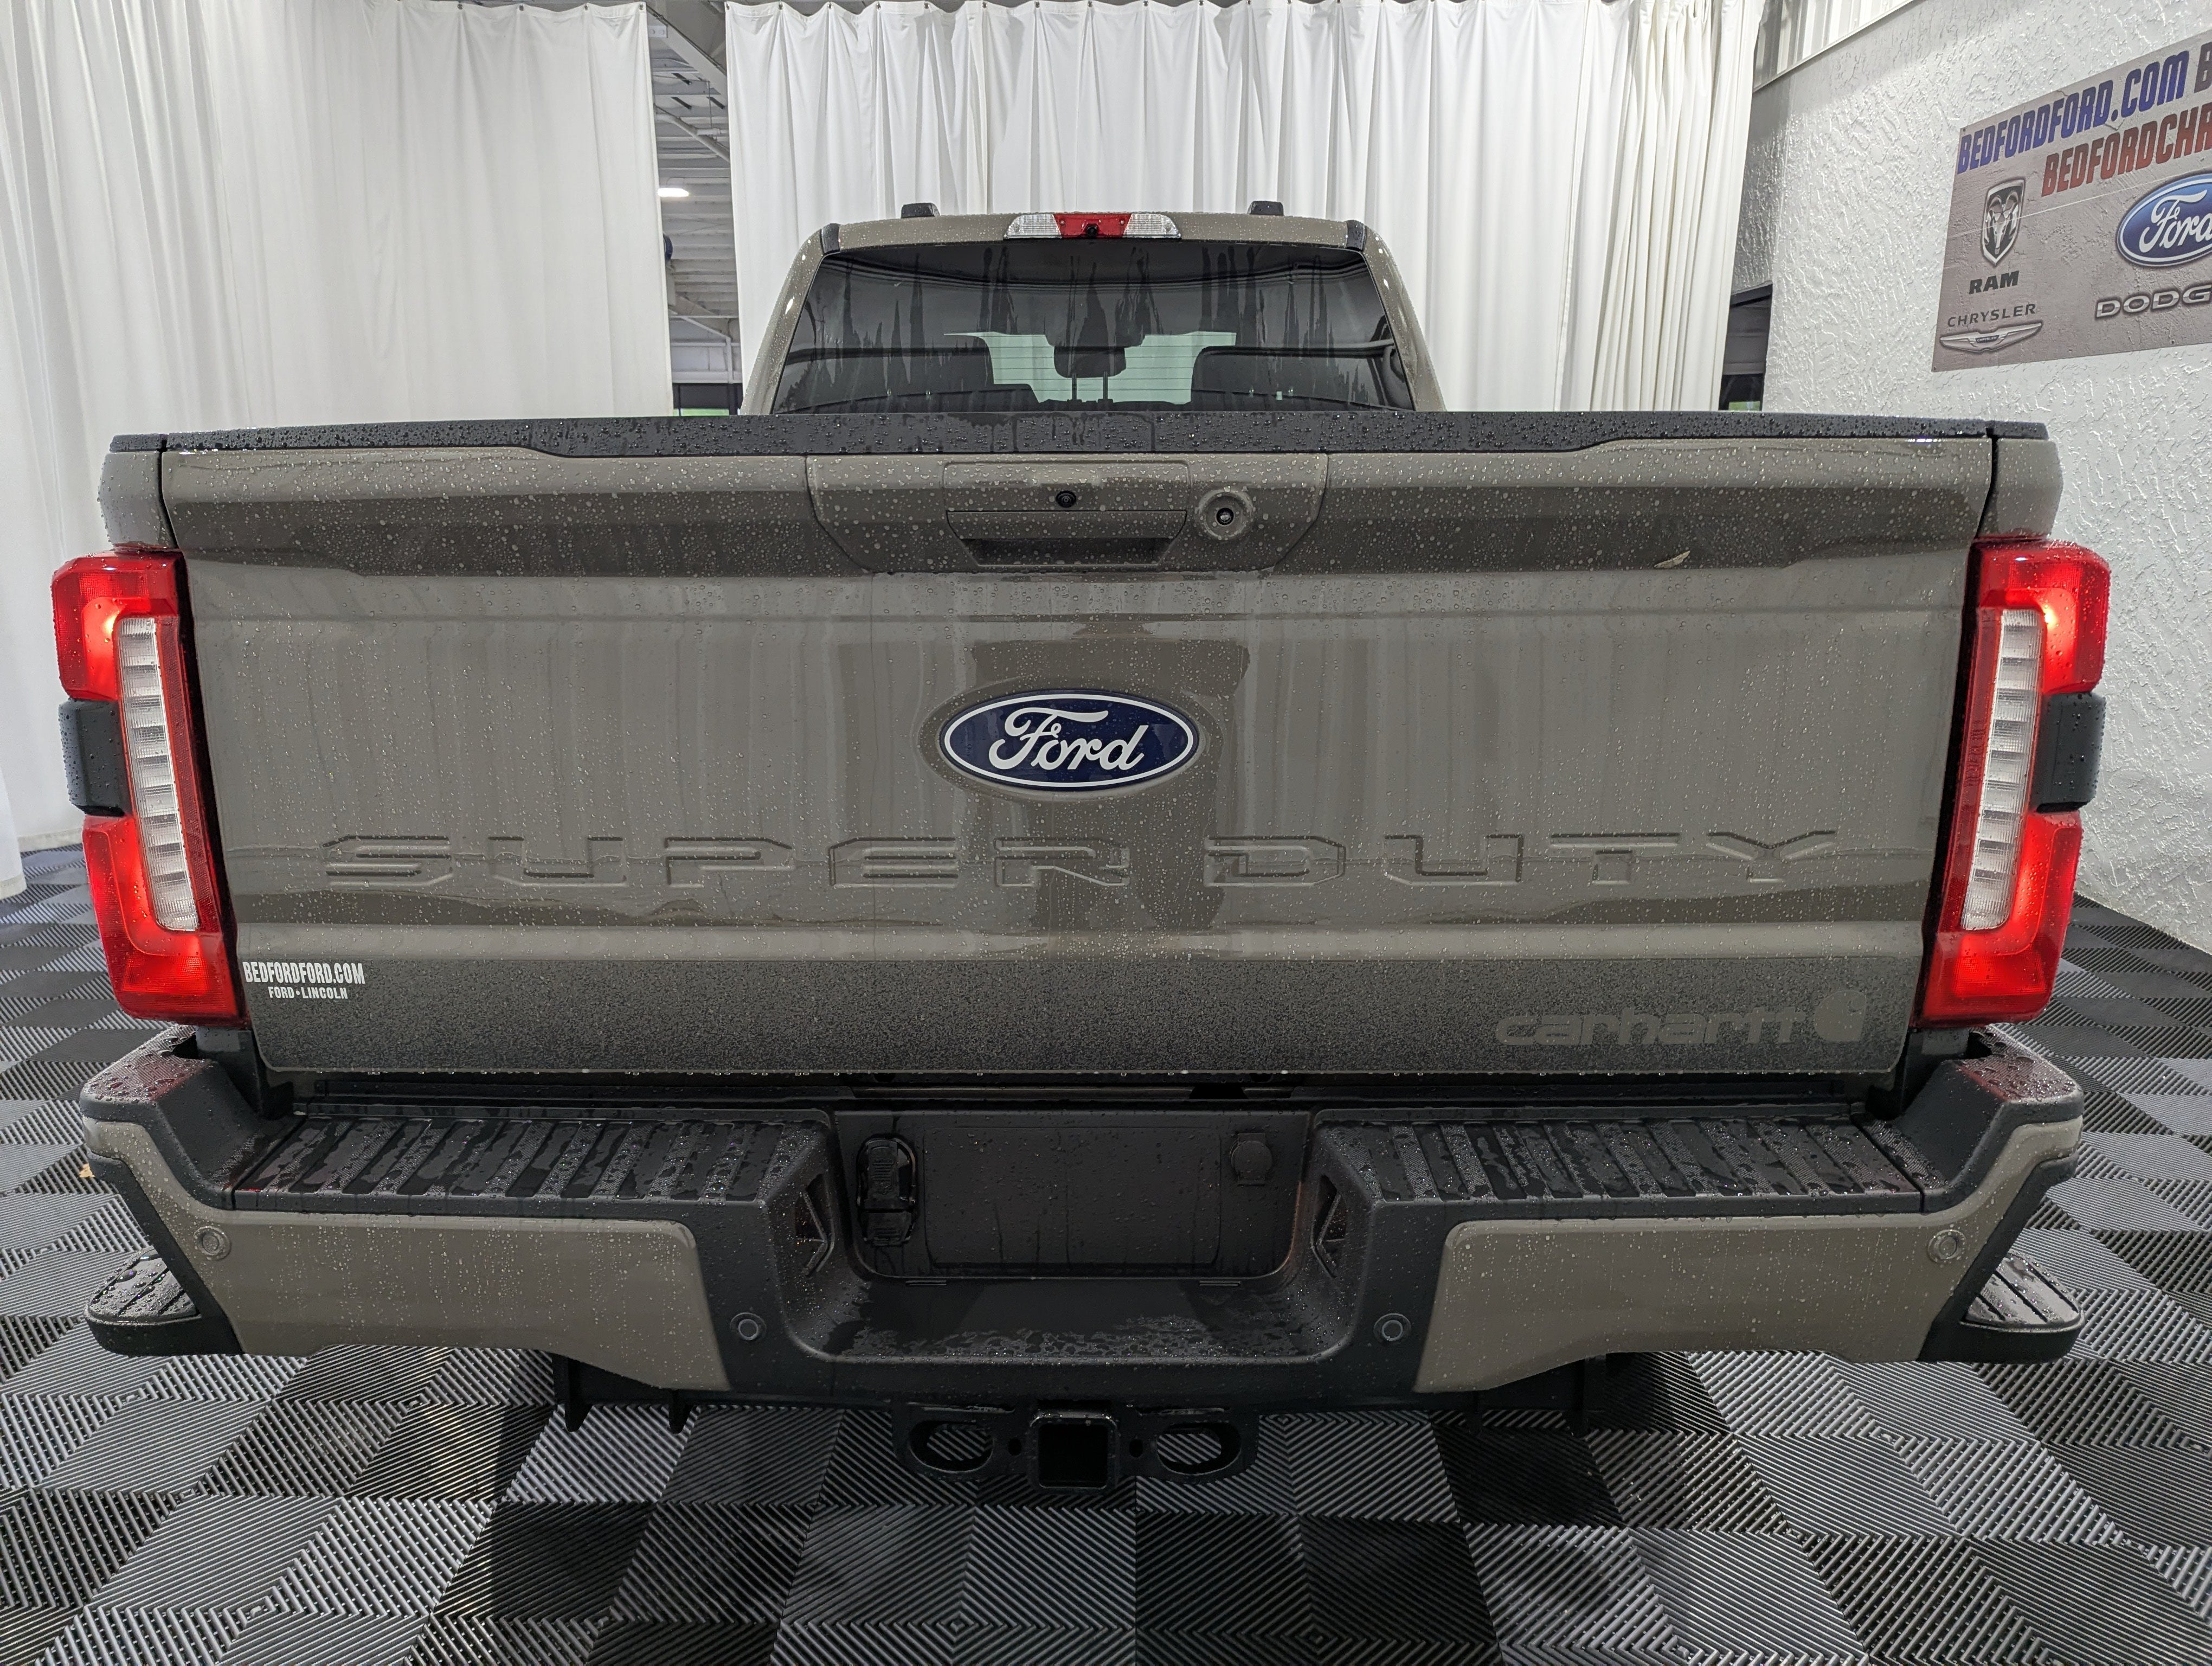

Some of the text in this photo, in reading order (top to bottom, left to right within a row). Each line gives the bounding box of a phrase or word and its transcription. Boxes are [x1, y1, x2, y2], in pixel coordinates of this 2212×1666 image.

[1957, 50, 2190, 175] BEDFORDFORD.COM
[2041, 101, 2212, 197] BEDFORDCHR
[1969, 271, 2020, 294] RAM
[2096, 284, 2212, 317] DODG
[1947, 303, 2036, 327] CHRYSLER
[988, 707, 1149, 770] Ford
[322, 830, 1838, 888] SUPER DUTY
[242, 962, 365, 984] BEDFORDFORD.COM
[268, 986, 348, 999] FORD LINCOLN
[1495, 1007, 1806, 1046] carhartt
